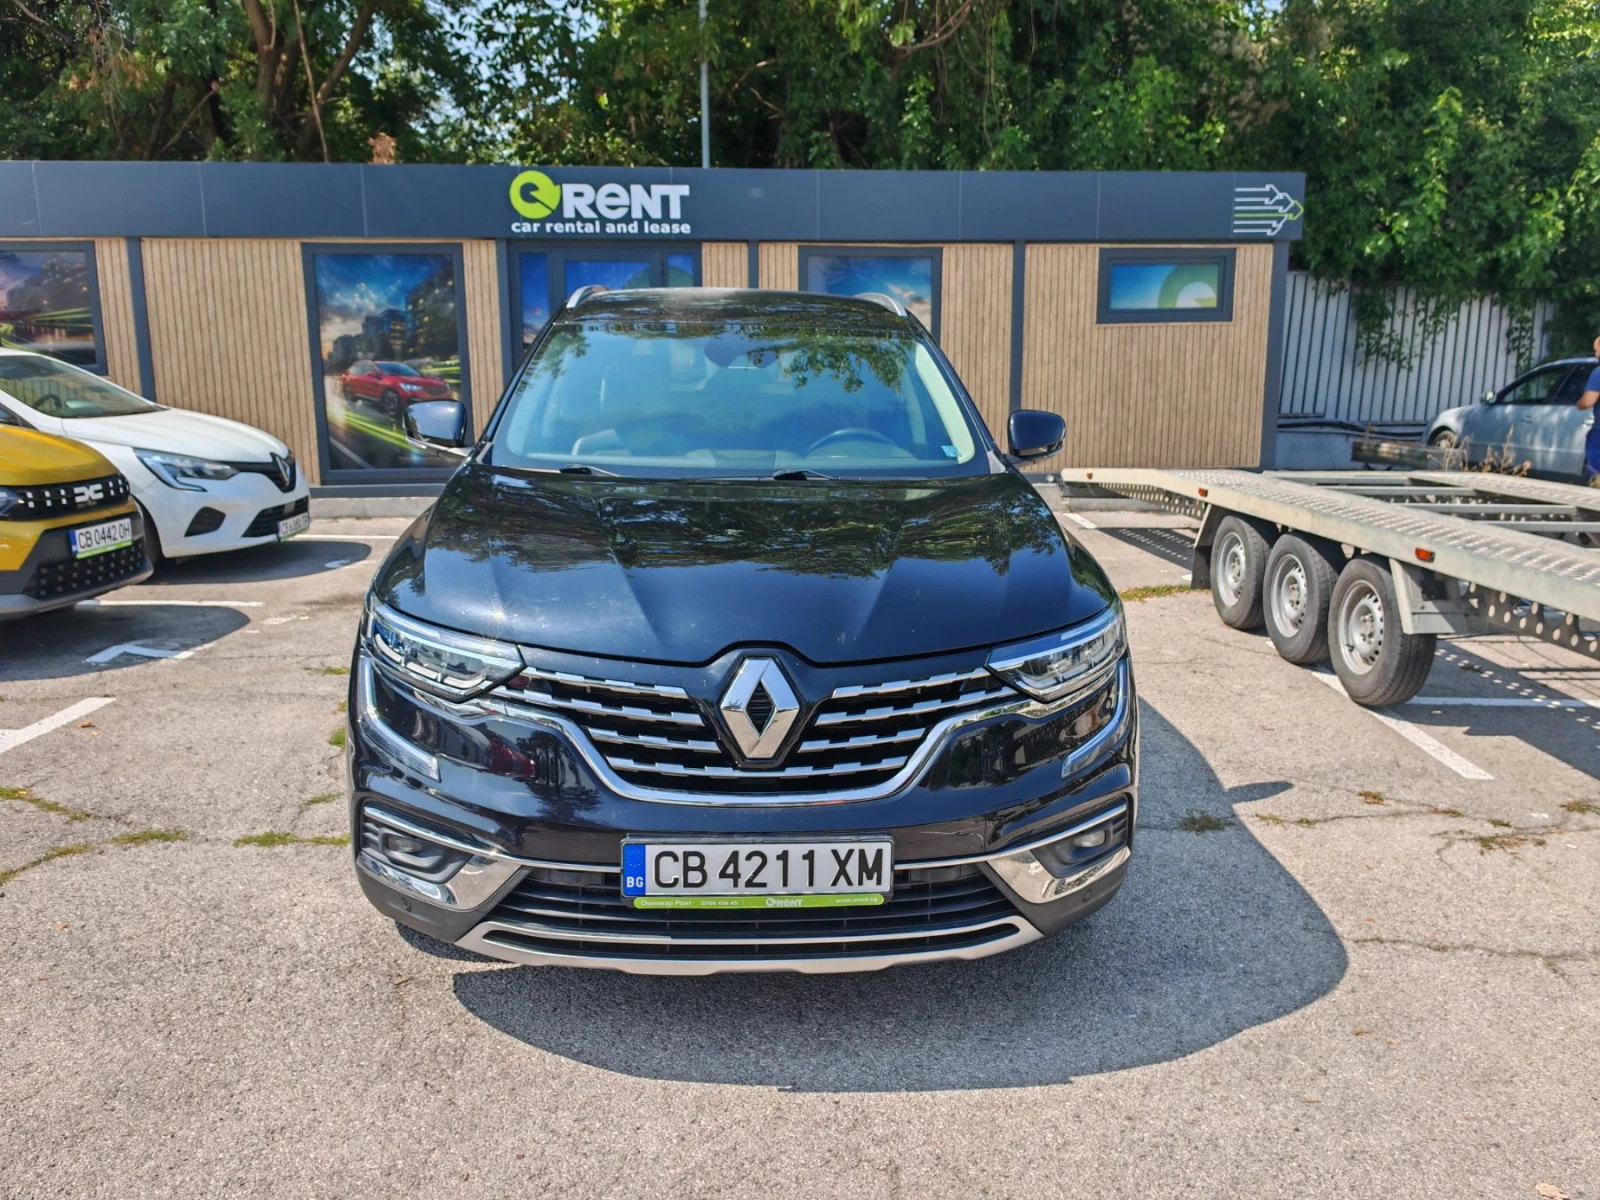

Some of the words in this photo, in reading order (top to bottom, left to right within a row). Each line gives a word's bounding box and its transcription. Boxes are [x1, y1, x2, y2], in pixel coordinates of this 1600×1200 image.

[511, 222, 541, 233] car
[546, 220, 600, 233] rental
[605, 220, 639, 234] and
[644, 220, 691, 234] lease
[78, 531, 93, 549] CB
[653, 850, 708, 889] CB
[718, 849, 815, 888] 4211
[830, 848, 884, 887] XM
[626, 876, 644, 888] BG
